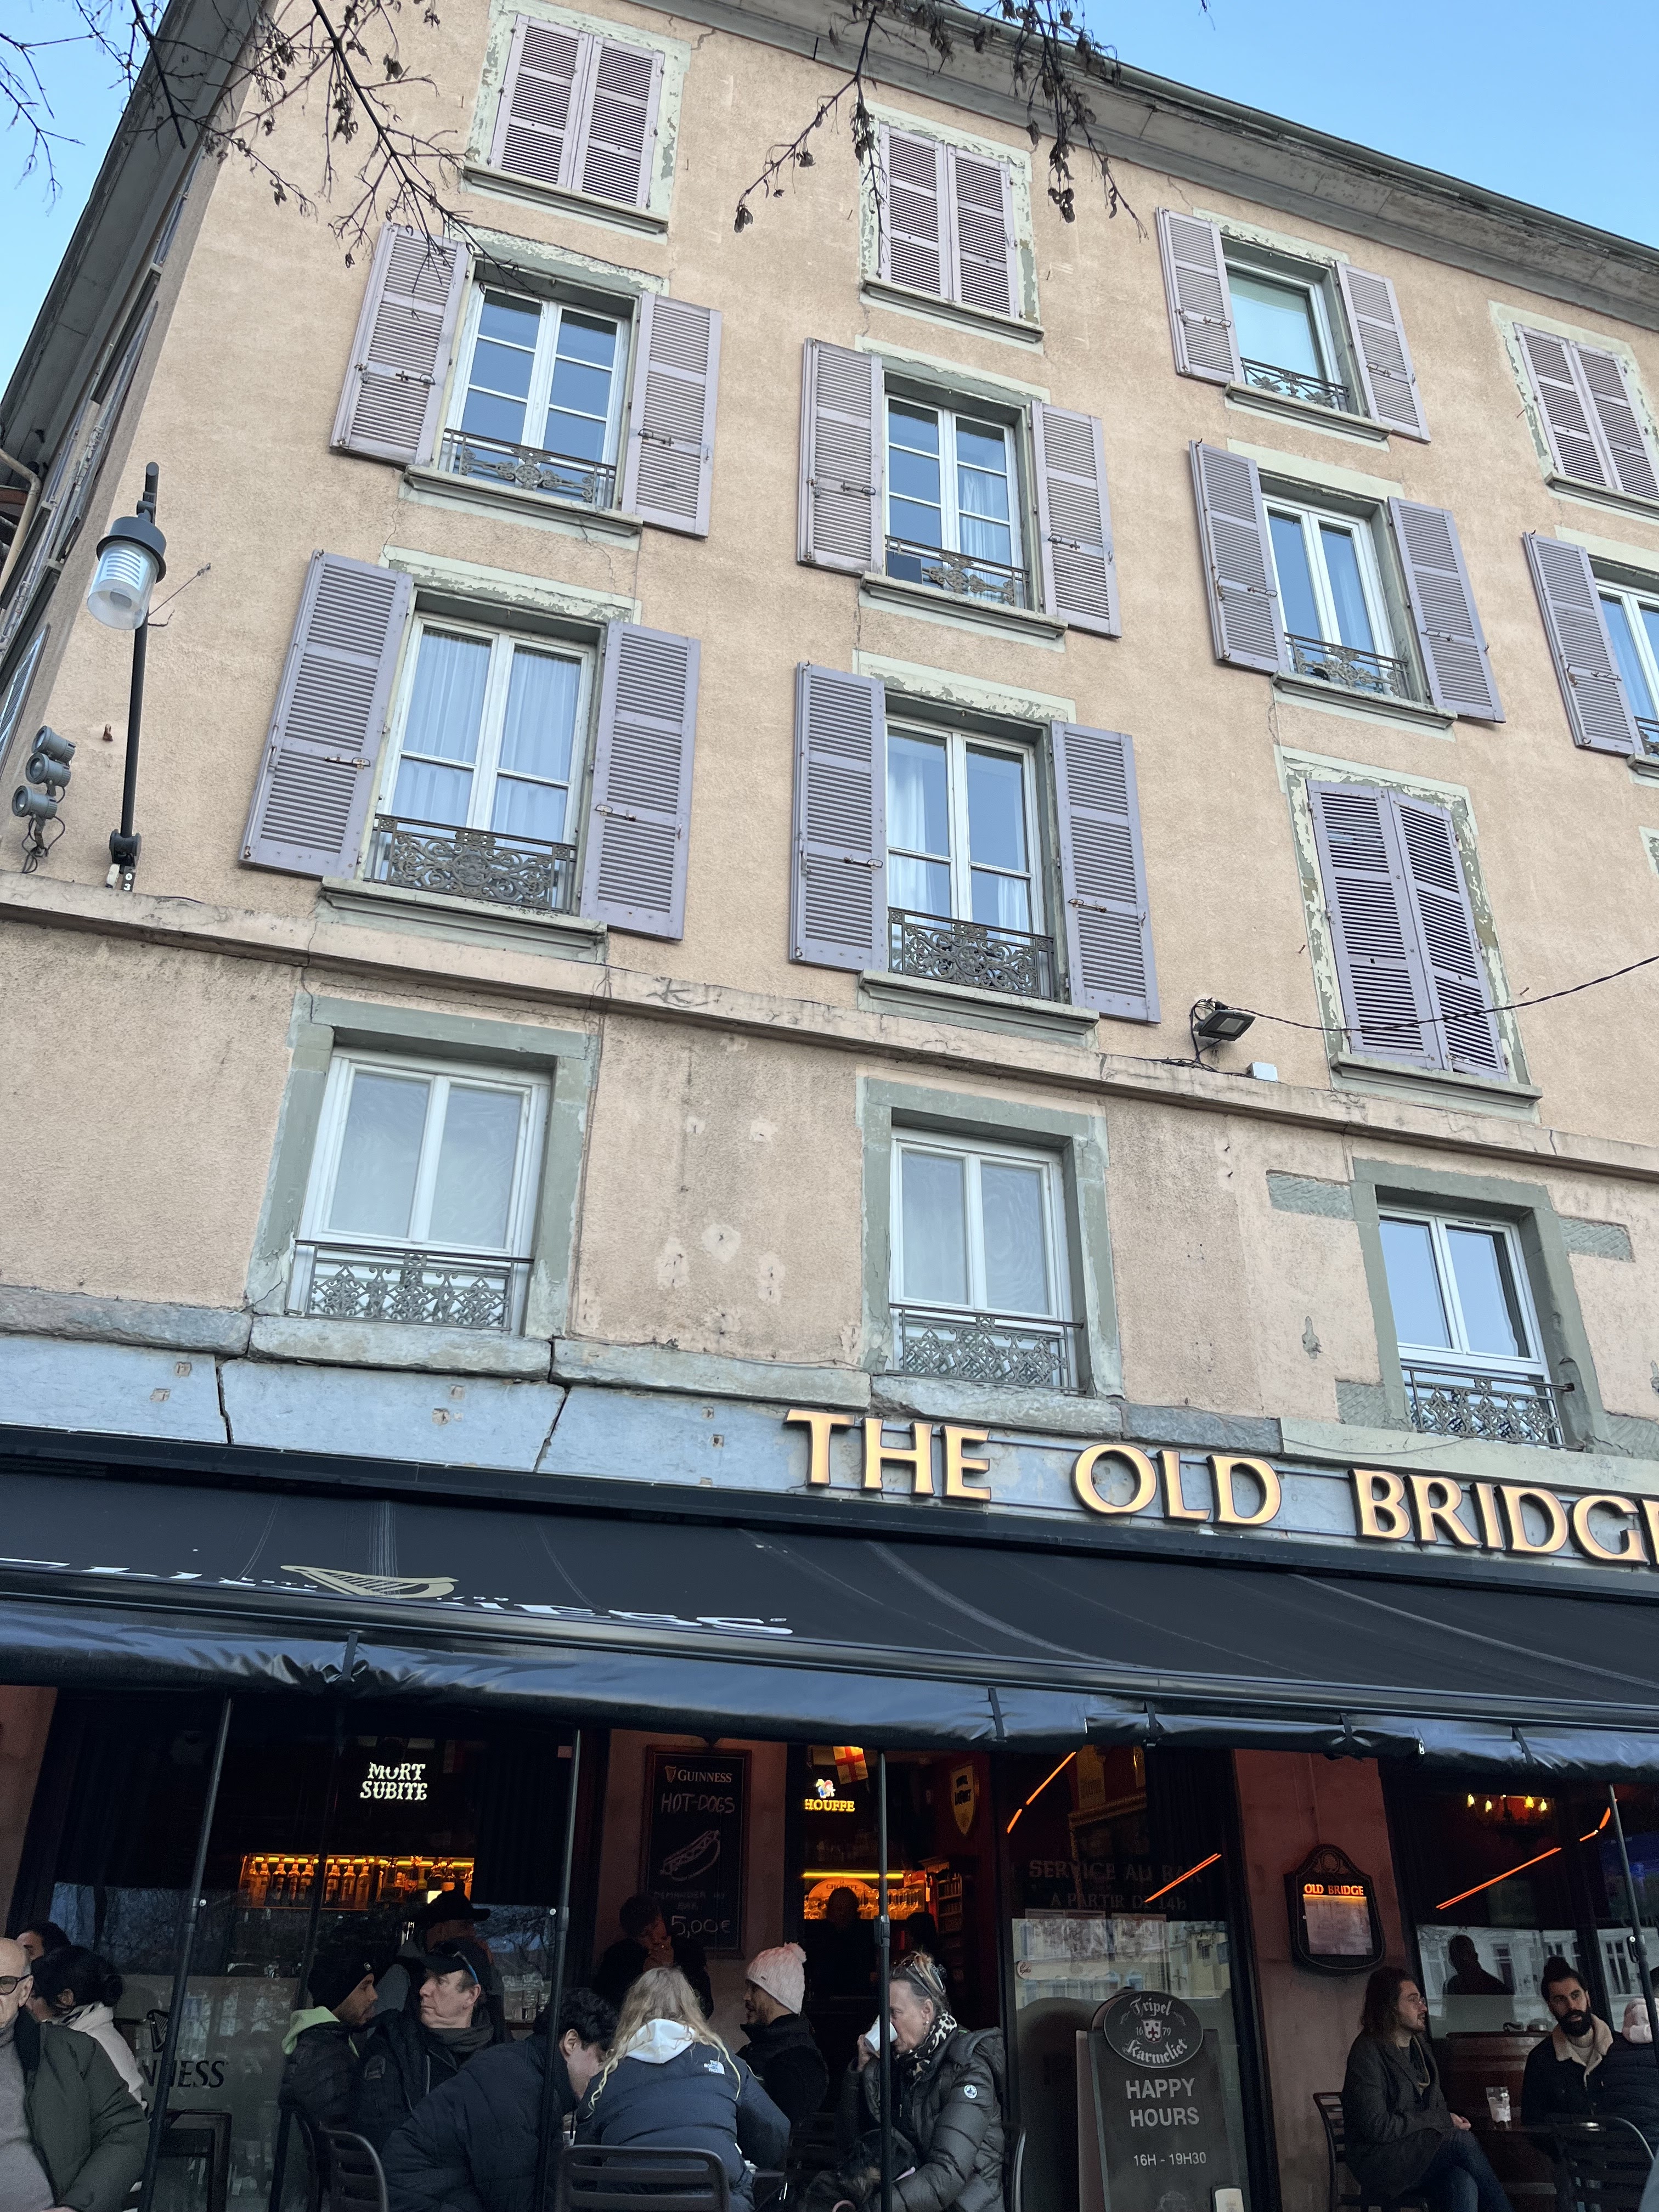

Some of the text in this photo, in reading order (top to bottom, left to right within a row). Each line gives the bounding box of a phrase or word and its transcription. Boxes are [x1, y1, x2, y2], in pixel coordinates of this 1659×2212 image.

[784, 1408, 991, 1501] THE
[1071, 1443, 1282, 1526] OLD
[678, 1769, 733, 1783] GUINNESS
[360, 1780, 428, 1801] SUBITE
[1028, 1859, 1116, 1879] SERVICE
[1125, 1864, 1153, 1882] AU
[1304, 1883, 1364, 1895] OLD BRIDGE
[1130, 1994, 1173, 2017] Tripel
[1136, 2027, 1171, 2036] 16 79
[1122, 2038, 1188, 2064] Karmeliet
[1126, 2078, 1195, 2099] HAPPY
[1130, 2107, 1200, 2127] HOURS
[1133, 2154, 1156, 2166] 16H
[1169, 2152, 1206, 2165] 19H30
